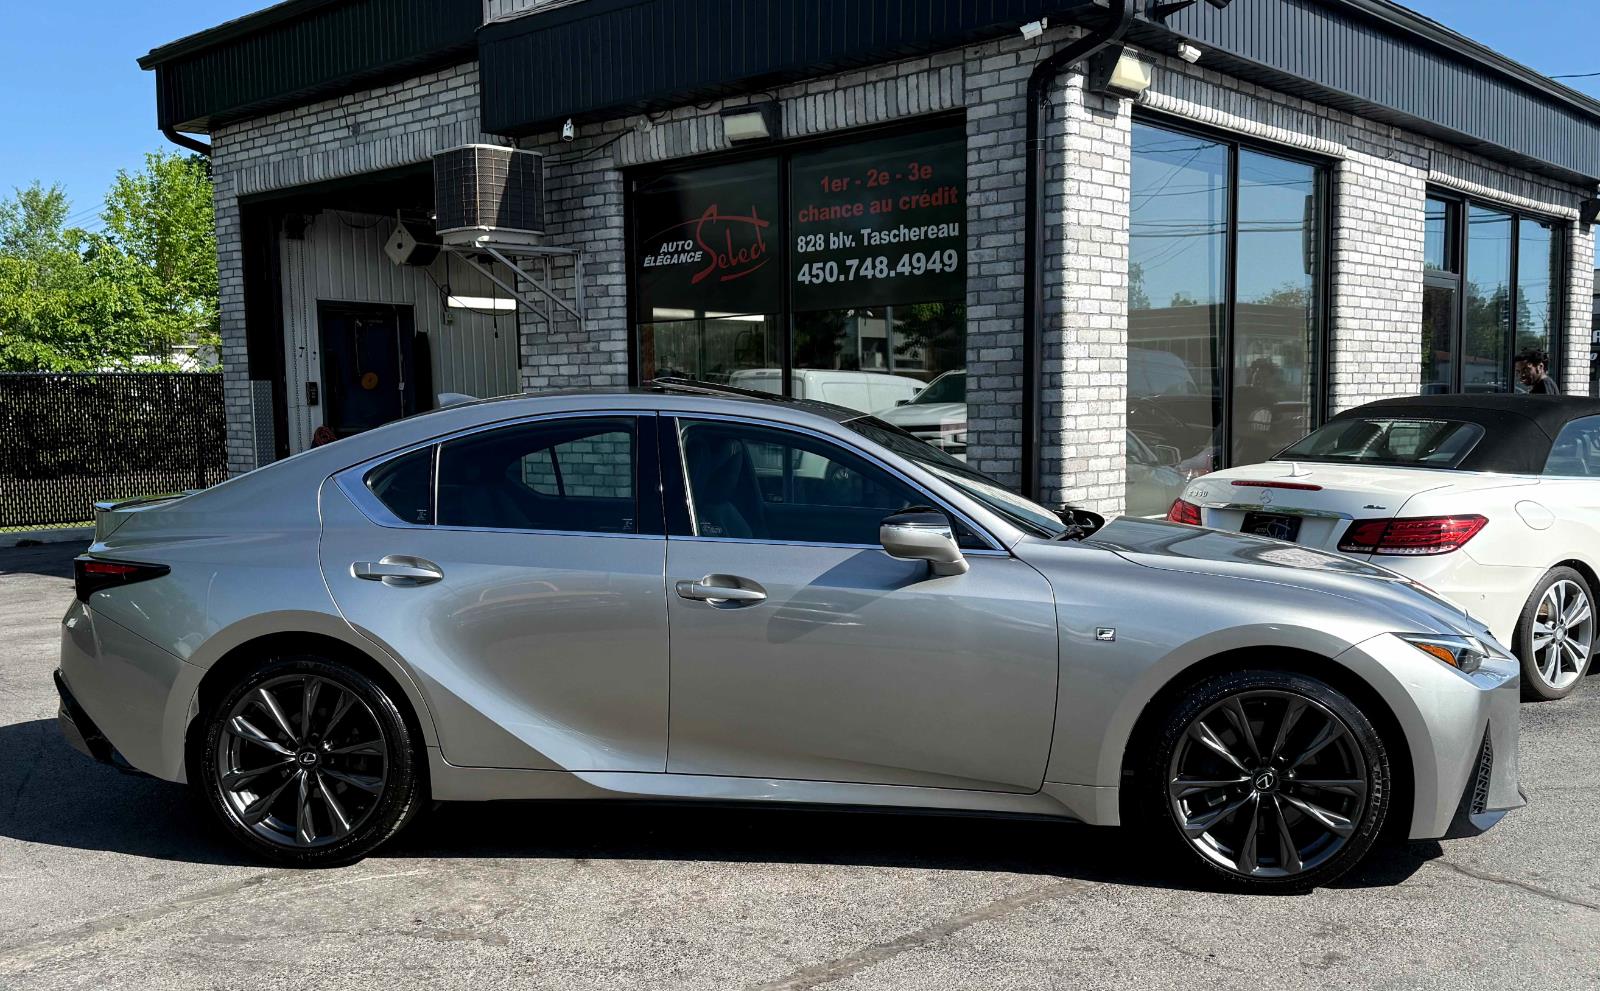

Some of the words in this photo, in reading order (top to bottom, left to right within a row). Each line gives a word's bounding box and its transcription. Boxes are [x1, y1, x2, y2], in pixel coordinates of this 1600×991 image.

[821, 175, 850, 193] 1er
[867, 168, 890, 188] 2e
[908, 162, 933, 181] 3e
[798, 202, 864, 223] chance
[870, 198, 892, 214] au
[899, 186, 959, 210] crédit
[660, 239, 693, 253] AUTO
[797, 234, 825, 253] 828
[829, 231, 856, 250] blv.
[860, 222, 960, 246] Taschereau
[643, 251, 703, 267] ÉLÉGANCE
[797, 249, 959, 285] 450.748.4949
